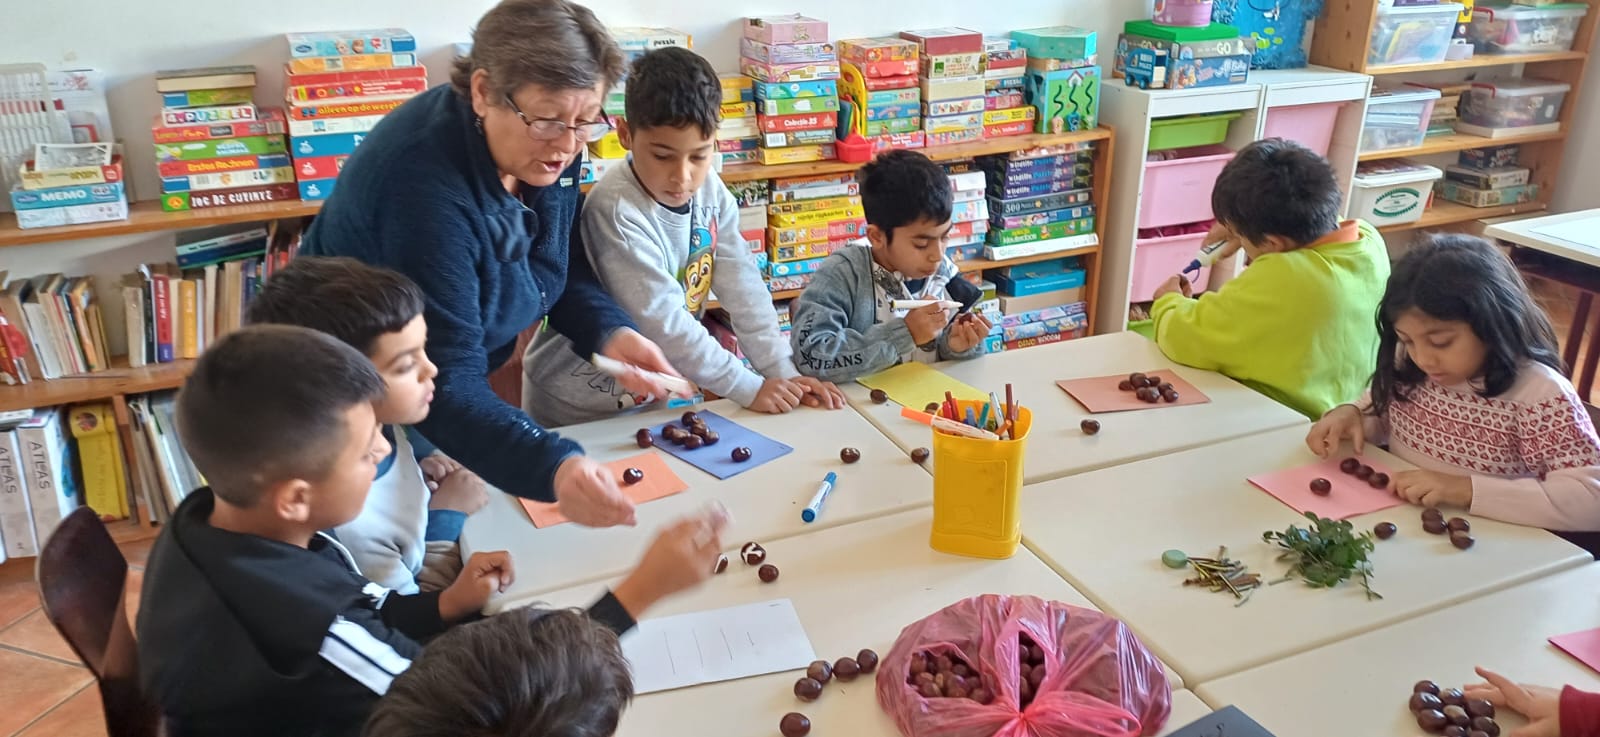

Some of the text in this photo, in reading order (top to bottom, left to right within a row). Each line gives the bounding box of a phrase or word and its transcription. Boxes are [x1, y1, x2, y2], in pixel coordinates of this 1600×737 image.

[1216, 41, 1232, 55] GO
[1009, 160, 1034, 169] Wildlife
[1008, 173, 1032, 182] Wildlife
[40, 190, 87, 202] MEMO
[1006, 186, 1030, 195] Wildlife
[191, 191, 273, 208] JOC DE CUVINTE
[1017, 338, 1036, 348] DINO
[814, 353, 863, 370] JEANS
[0, 447, 17, 494] ATLAS
[30, 441, 51, 490] ATLAS
